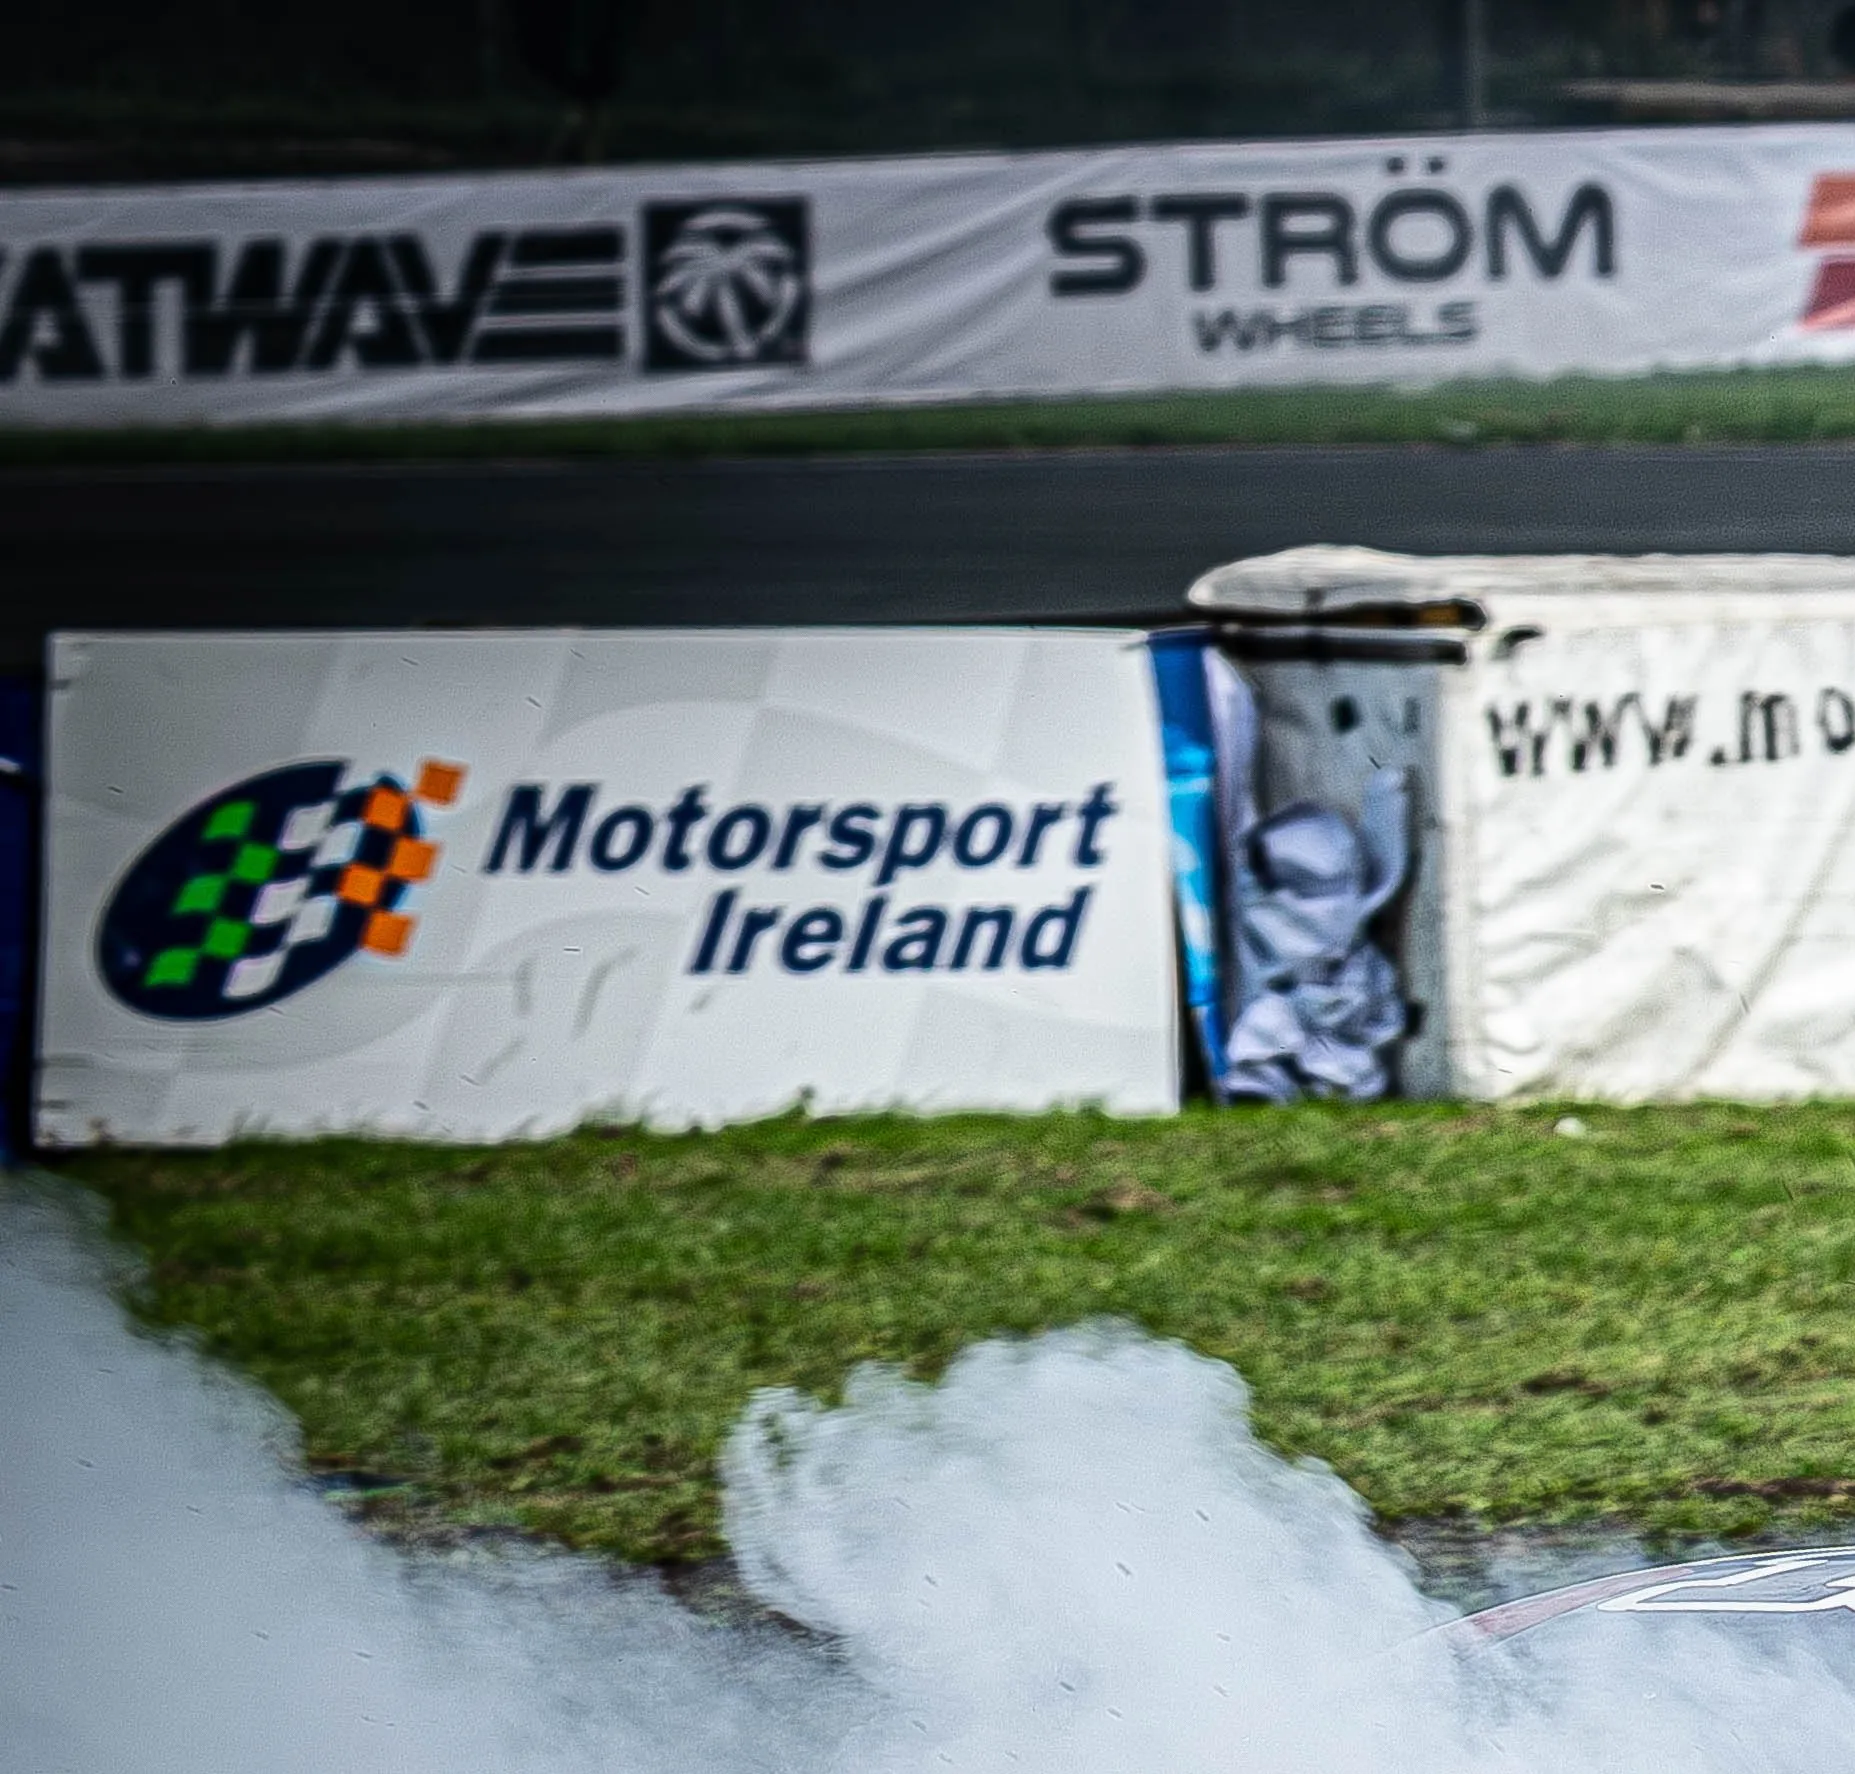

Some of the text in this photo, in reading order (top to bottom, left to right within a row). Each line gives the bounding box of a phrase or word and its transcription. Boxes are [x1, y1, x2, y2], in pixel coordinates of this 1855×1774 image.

[1047, 156, 1619, 298] STRÖM
[0, 222, 626, 384] ATWAVE
[1195, 300, 1482, 353] WHEELS
[482, 782, 1117, 885] Motorsport
[689, 882, 1095, 977] Ireland
